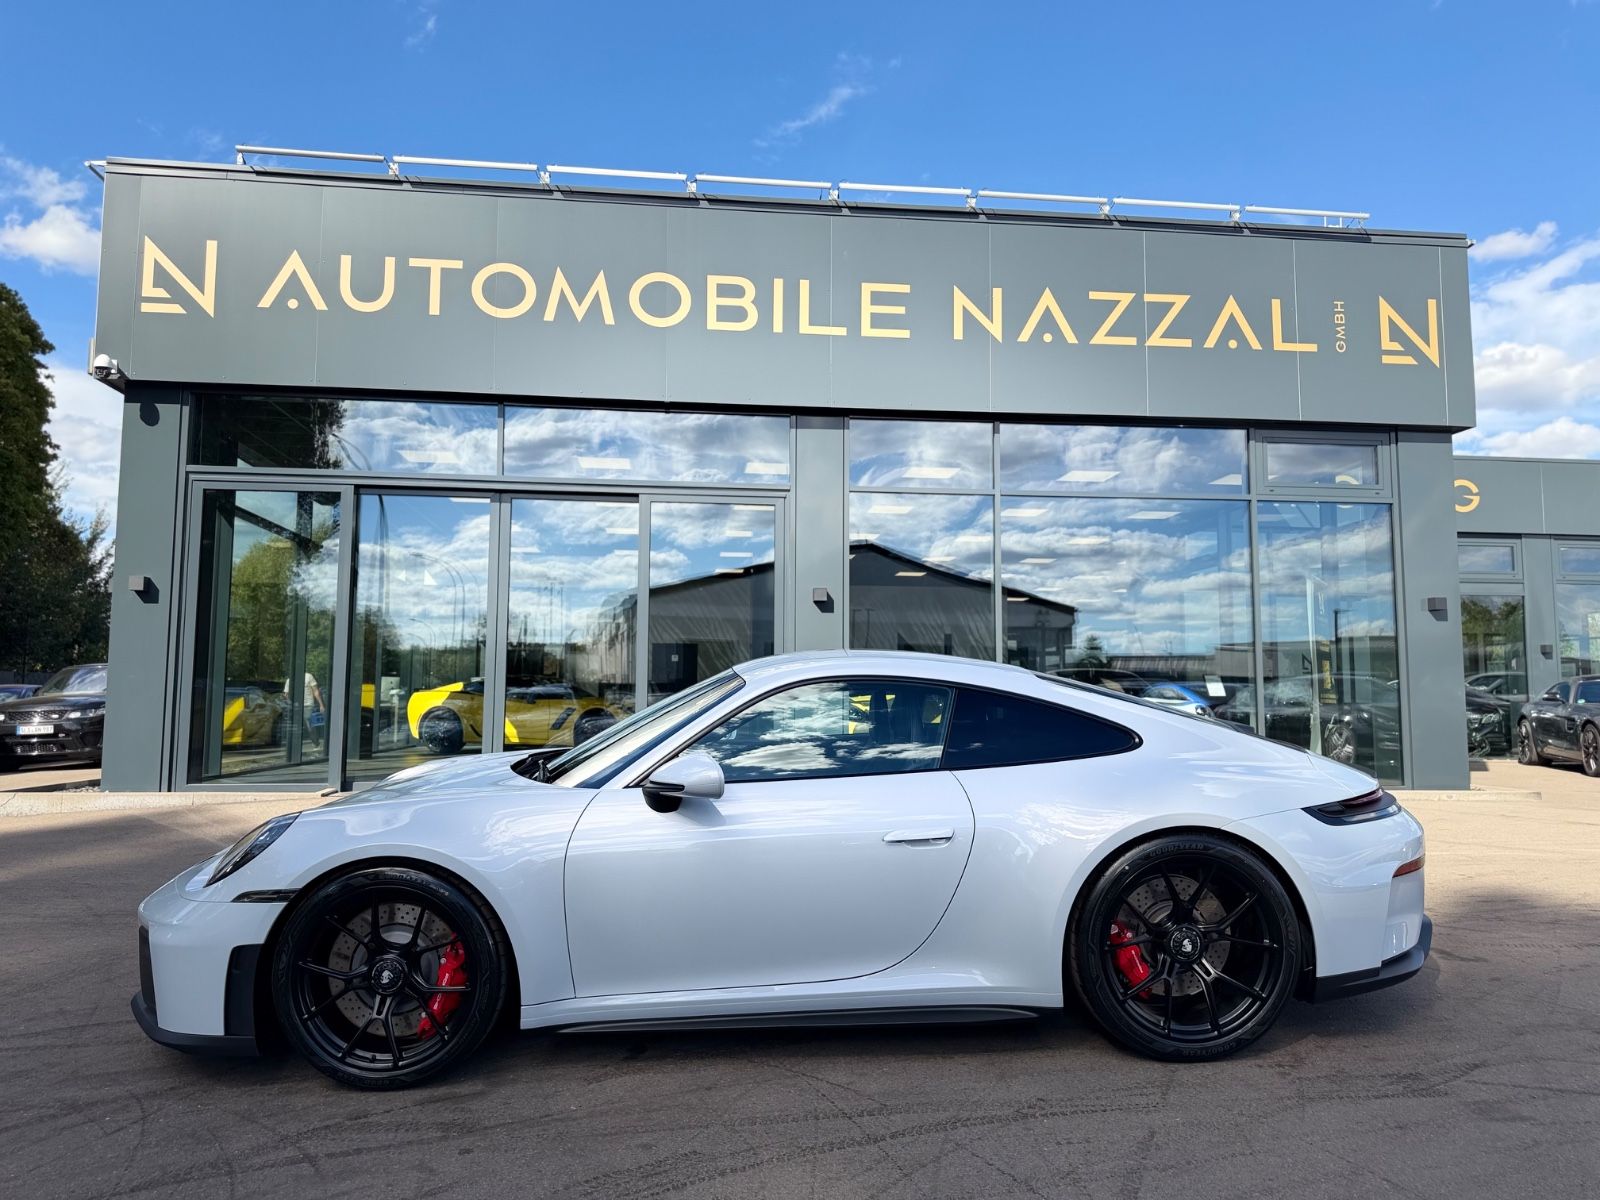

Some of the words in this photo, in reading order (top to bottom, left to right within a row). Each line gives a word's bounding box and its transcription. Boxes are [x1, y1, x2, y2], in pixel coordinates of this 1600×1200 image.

[256, 249, 912, 340] AUTOMOBILE
[953, 286, 1318, 354] NAZZAL
[1333, 300, 1347, 354] GMBH
